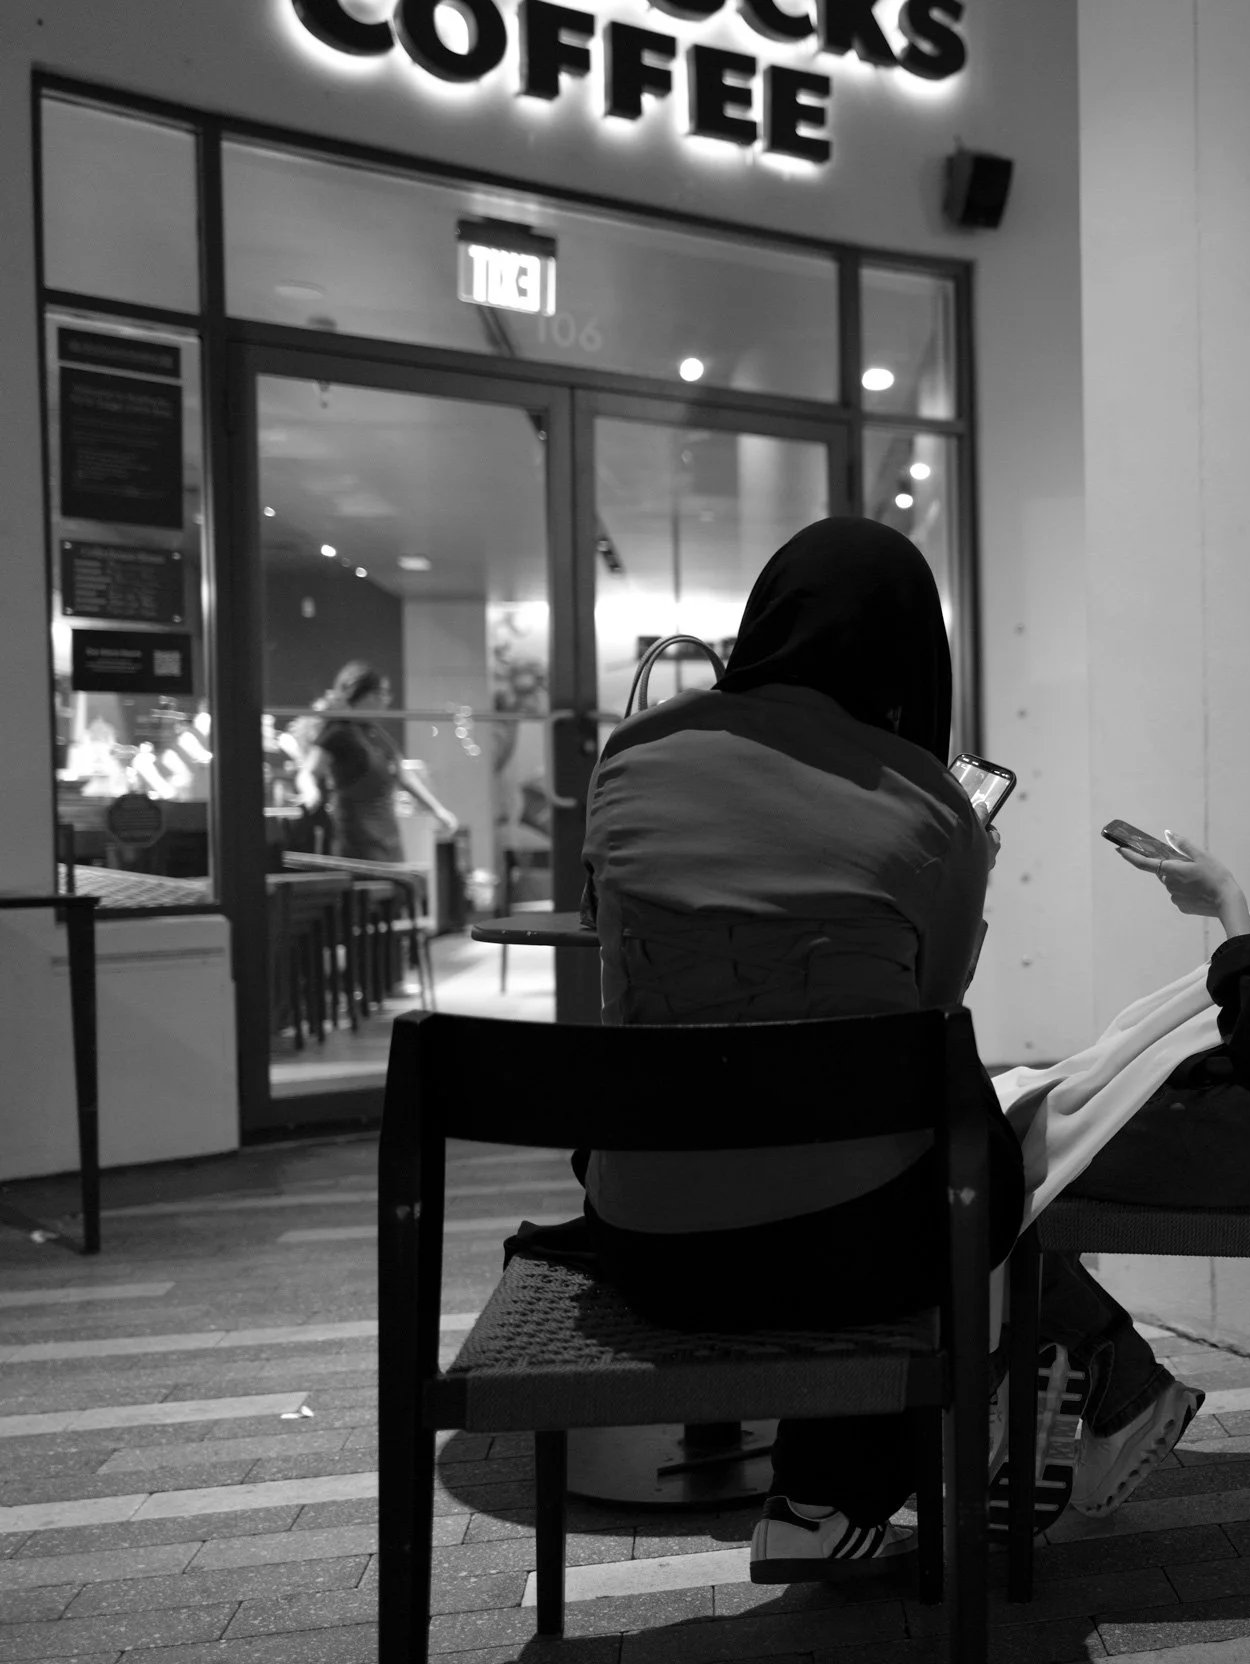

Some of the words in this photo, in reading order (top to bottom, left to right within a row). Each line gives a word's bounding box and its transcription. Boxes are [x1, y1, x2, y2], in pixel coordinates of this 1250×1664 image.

[649, 0, 965, 80] KS
[293, 0, 831, 163] COFFEE
[538, 311, 603, 352] 106
